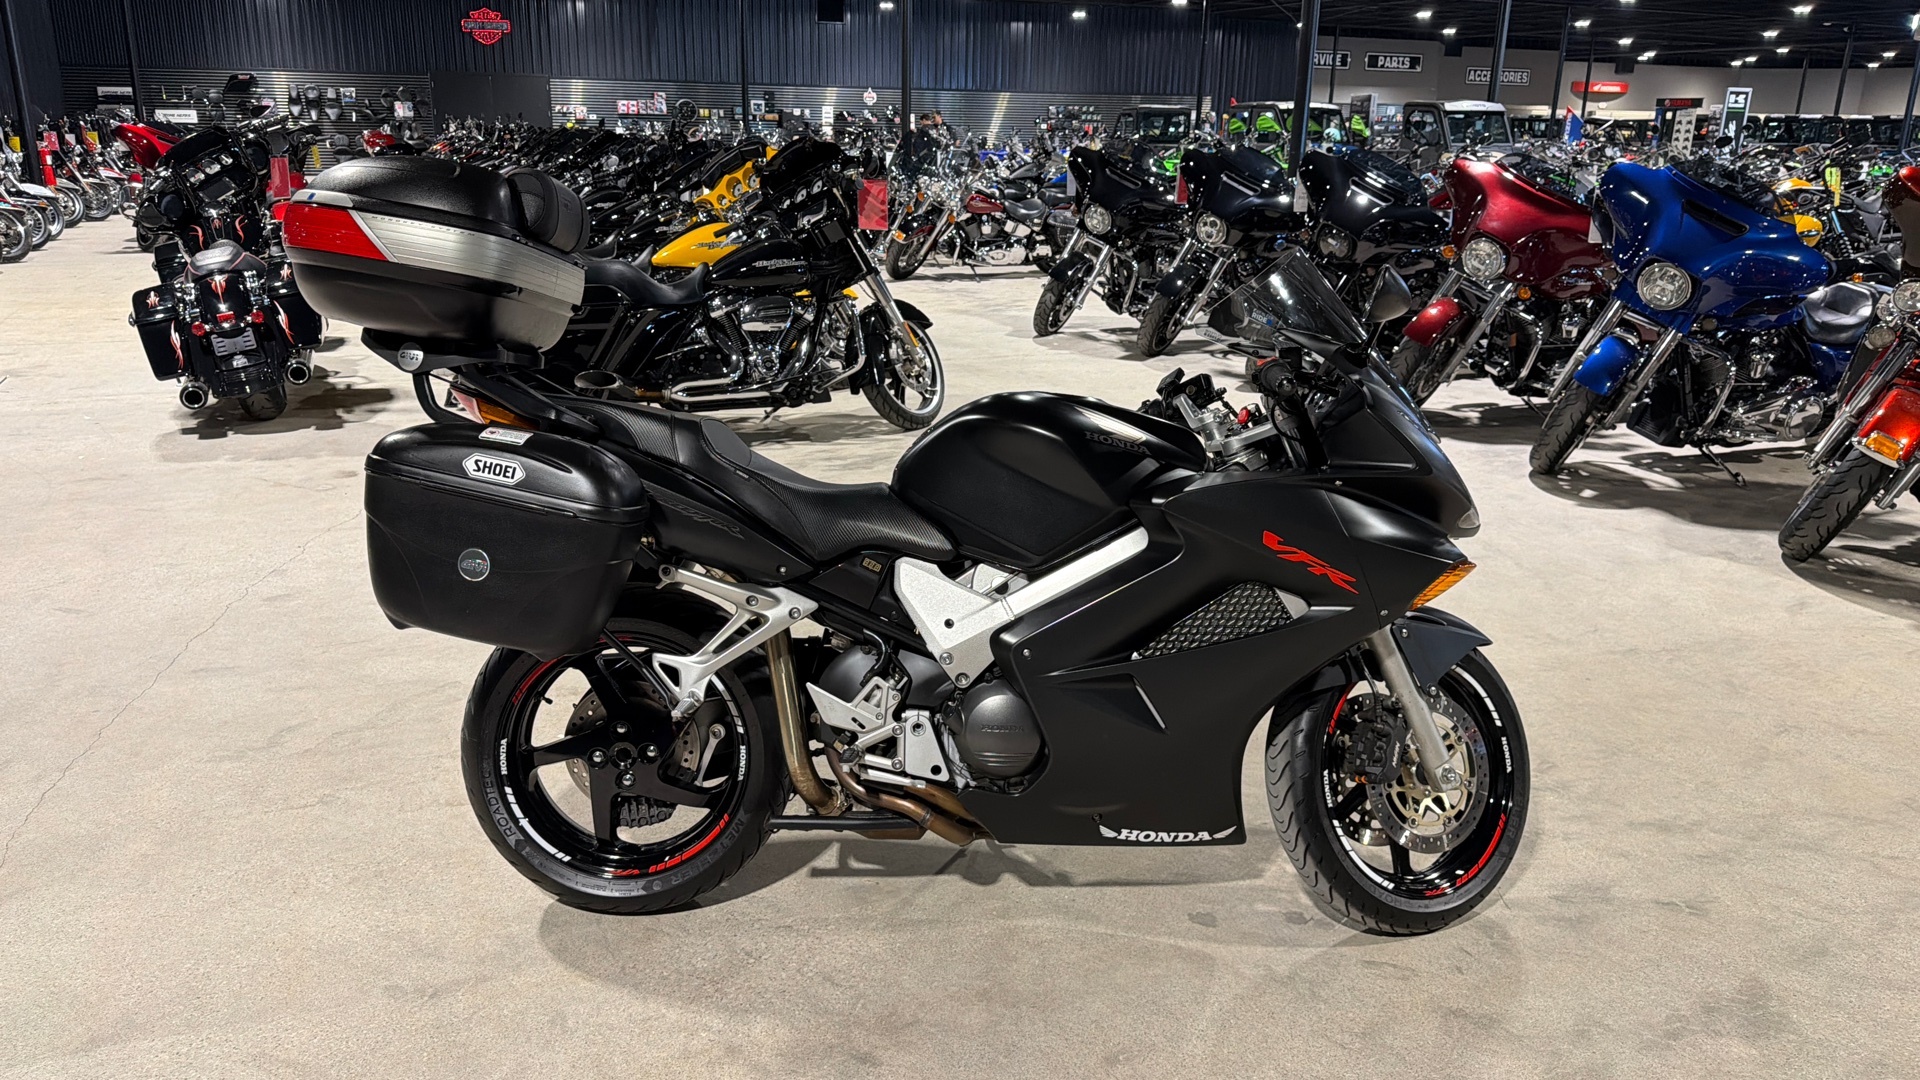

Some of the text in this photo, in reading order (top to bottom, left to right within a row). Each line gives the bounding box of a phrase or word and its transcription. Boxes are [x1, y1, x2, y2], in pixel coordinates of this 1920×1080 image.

[1378, 56, 1411, 69] PARTS
[1468, 70, 1528, 83] ACCESORIES
[1084, 430, 1153, 456] HONDA
[473, 459, 517, 480] SHOEI
[1262, 530, 1360, 595] VFR
[500, 737, 508, 775] HONDA
[737, 744, 747, 781] HONDA
[1501, 736, 1513, 774] HONDA
[1323, 768, 1334, 808] HONDA
[1116, 828, 1213, 843] HONDA
